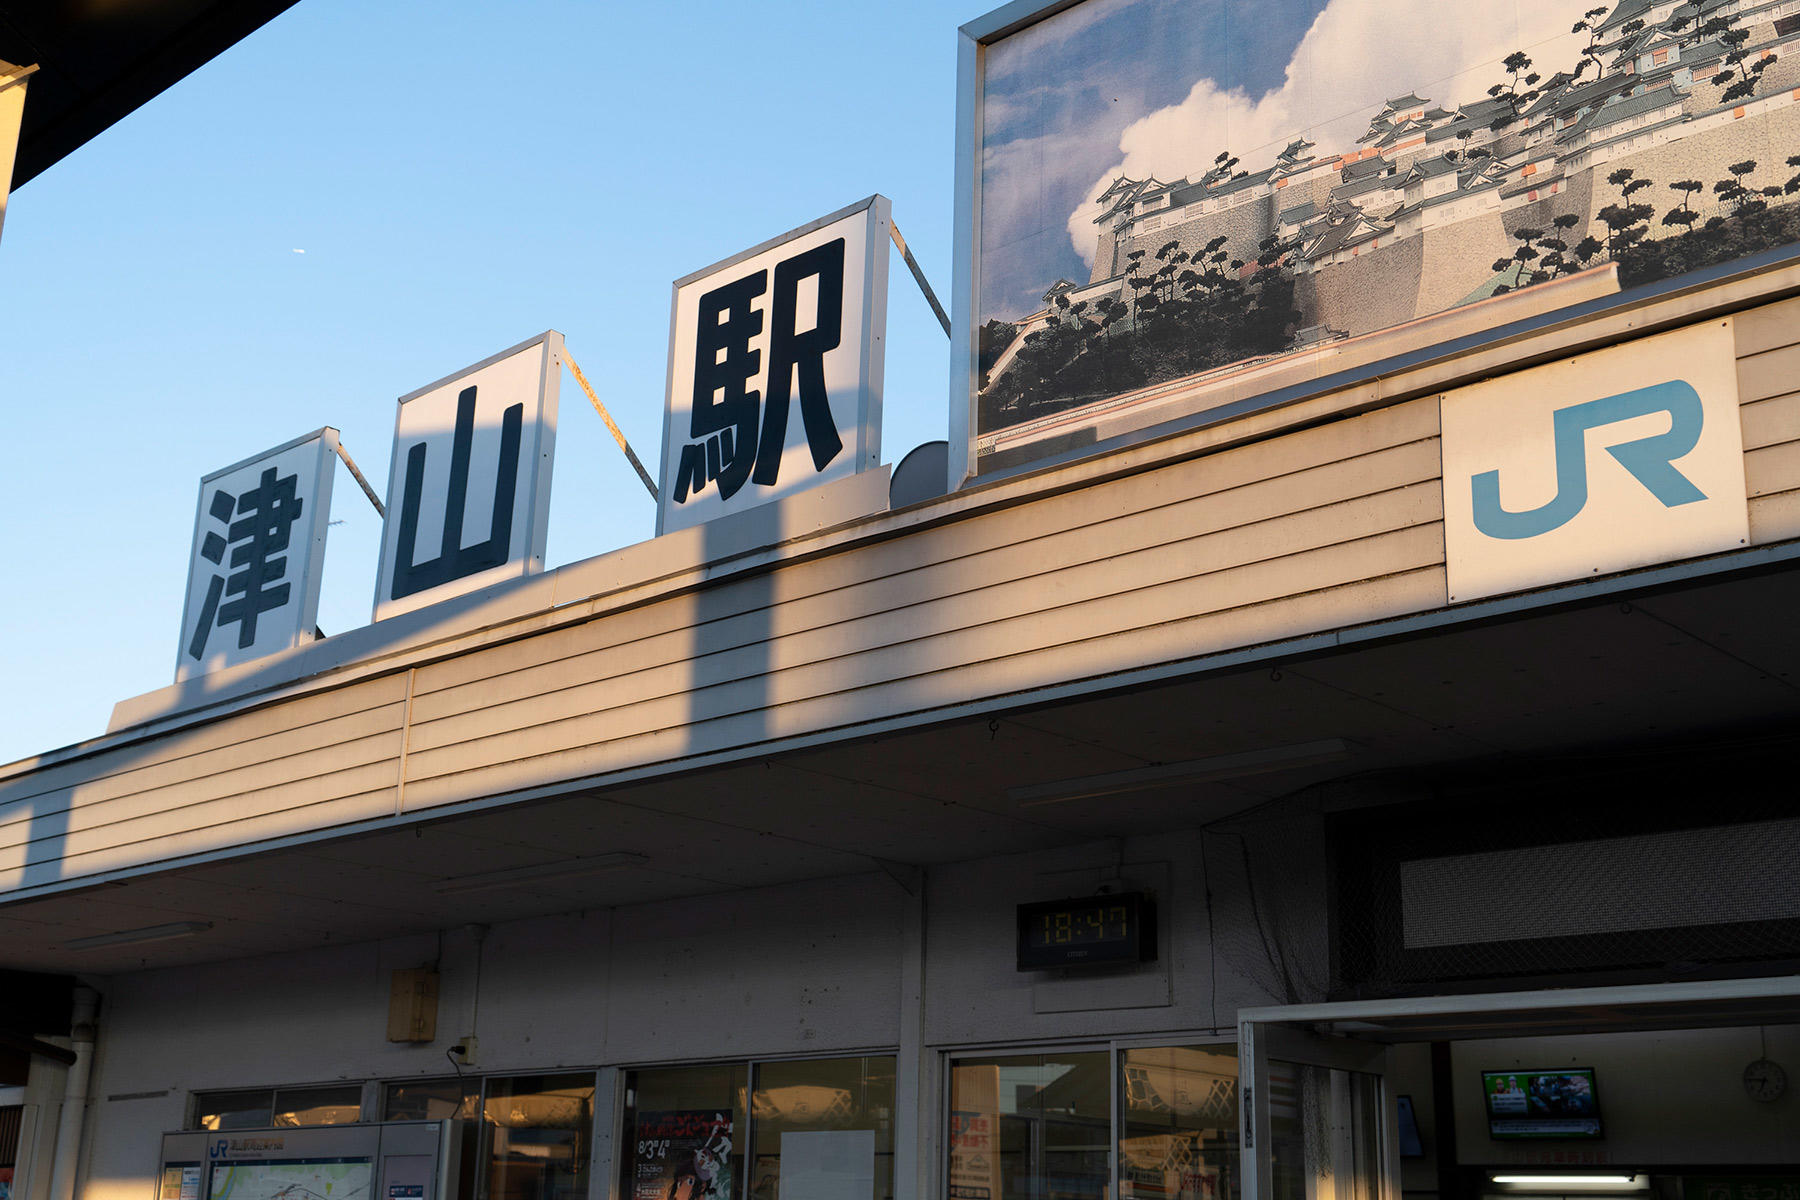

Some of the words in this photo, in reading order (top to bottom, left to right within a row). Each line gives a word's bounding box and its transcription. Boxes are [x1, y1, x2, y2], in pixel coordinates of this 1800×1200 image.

[189, 237, 846, 661] 津山駅
[1471, 379, 1709, 540] JR
[1044, 906, 1127, 945] 18:47
[210, 1140, 229, 1159] JR
